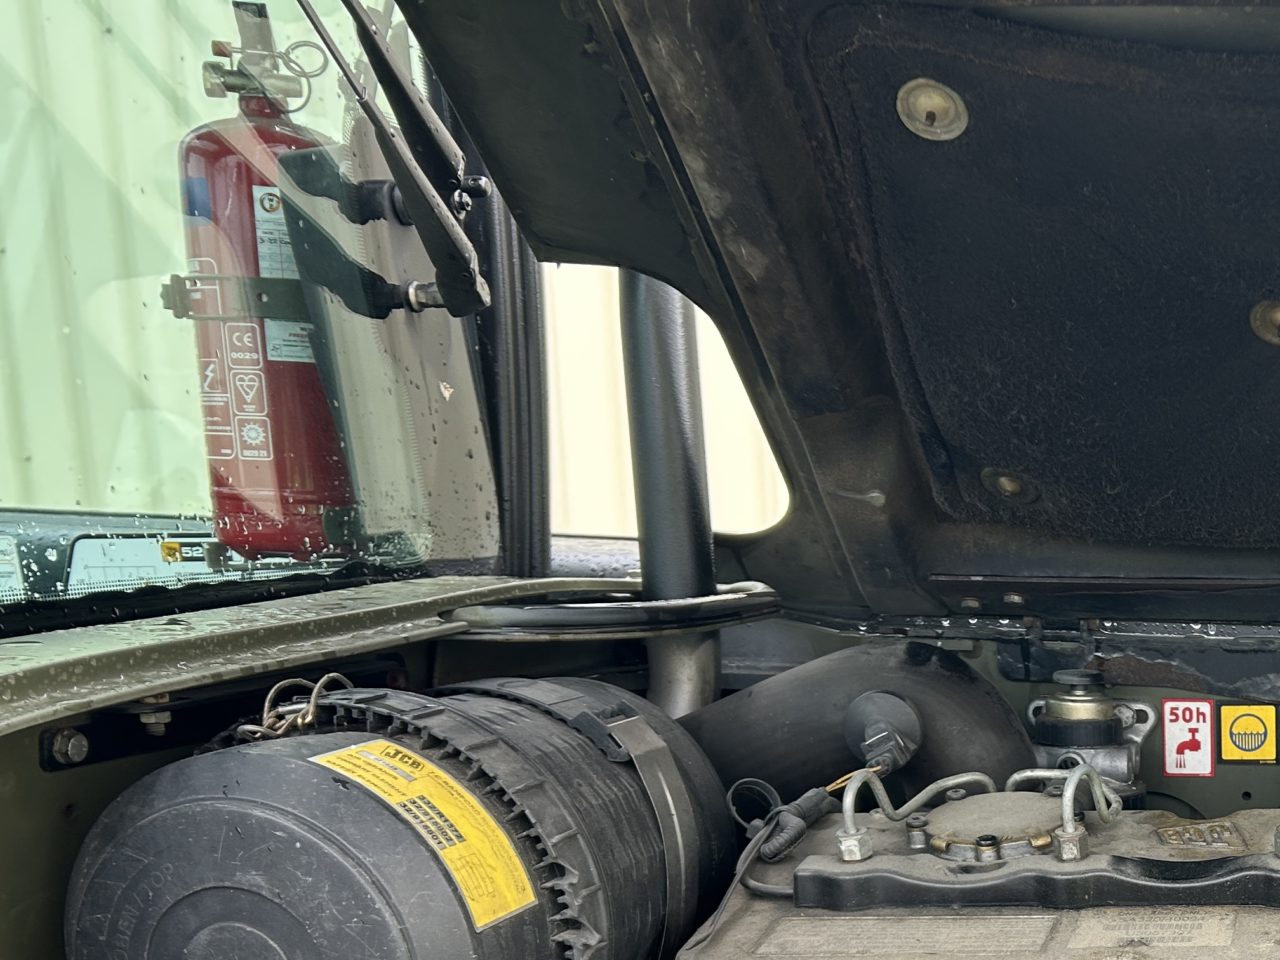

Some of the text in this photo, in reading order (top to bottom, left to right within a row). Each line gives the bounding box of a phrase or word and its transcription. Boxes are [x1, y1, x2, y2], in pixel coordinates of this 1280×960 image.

[181, 546, 204, 557] 52
[1169, 707, 1207, 723] 50h
[384, 748, 422, 770] JCB
